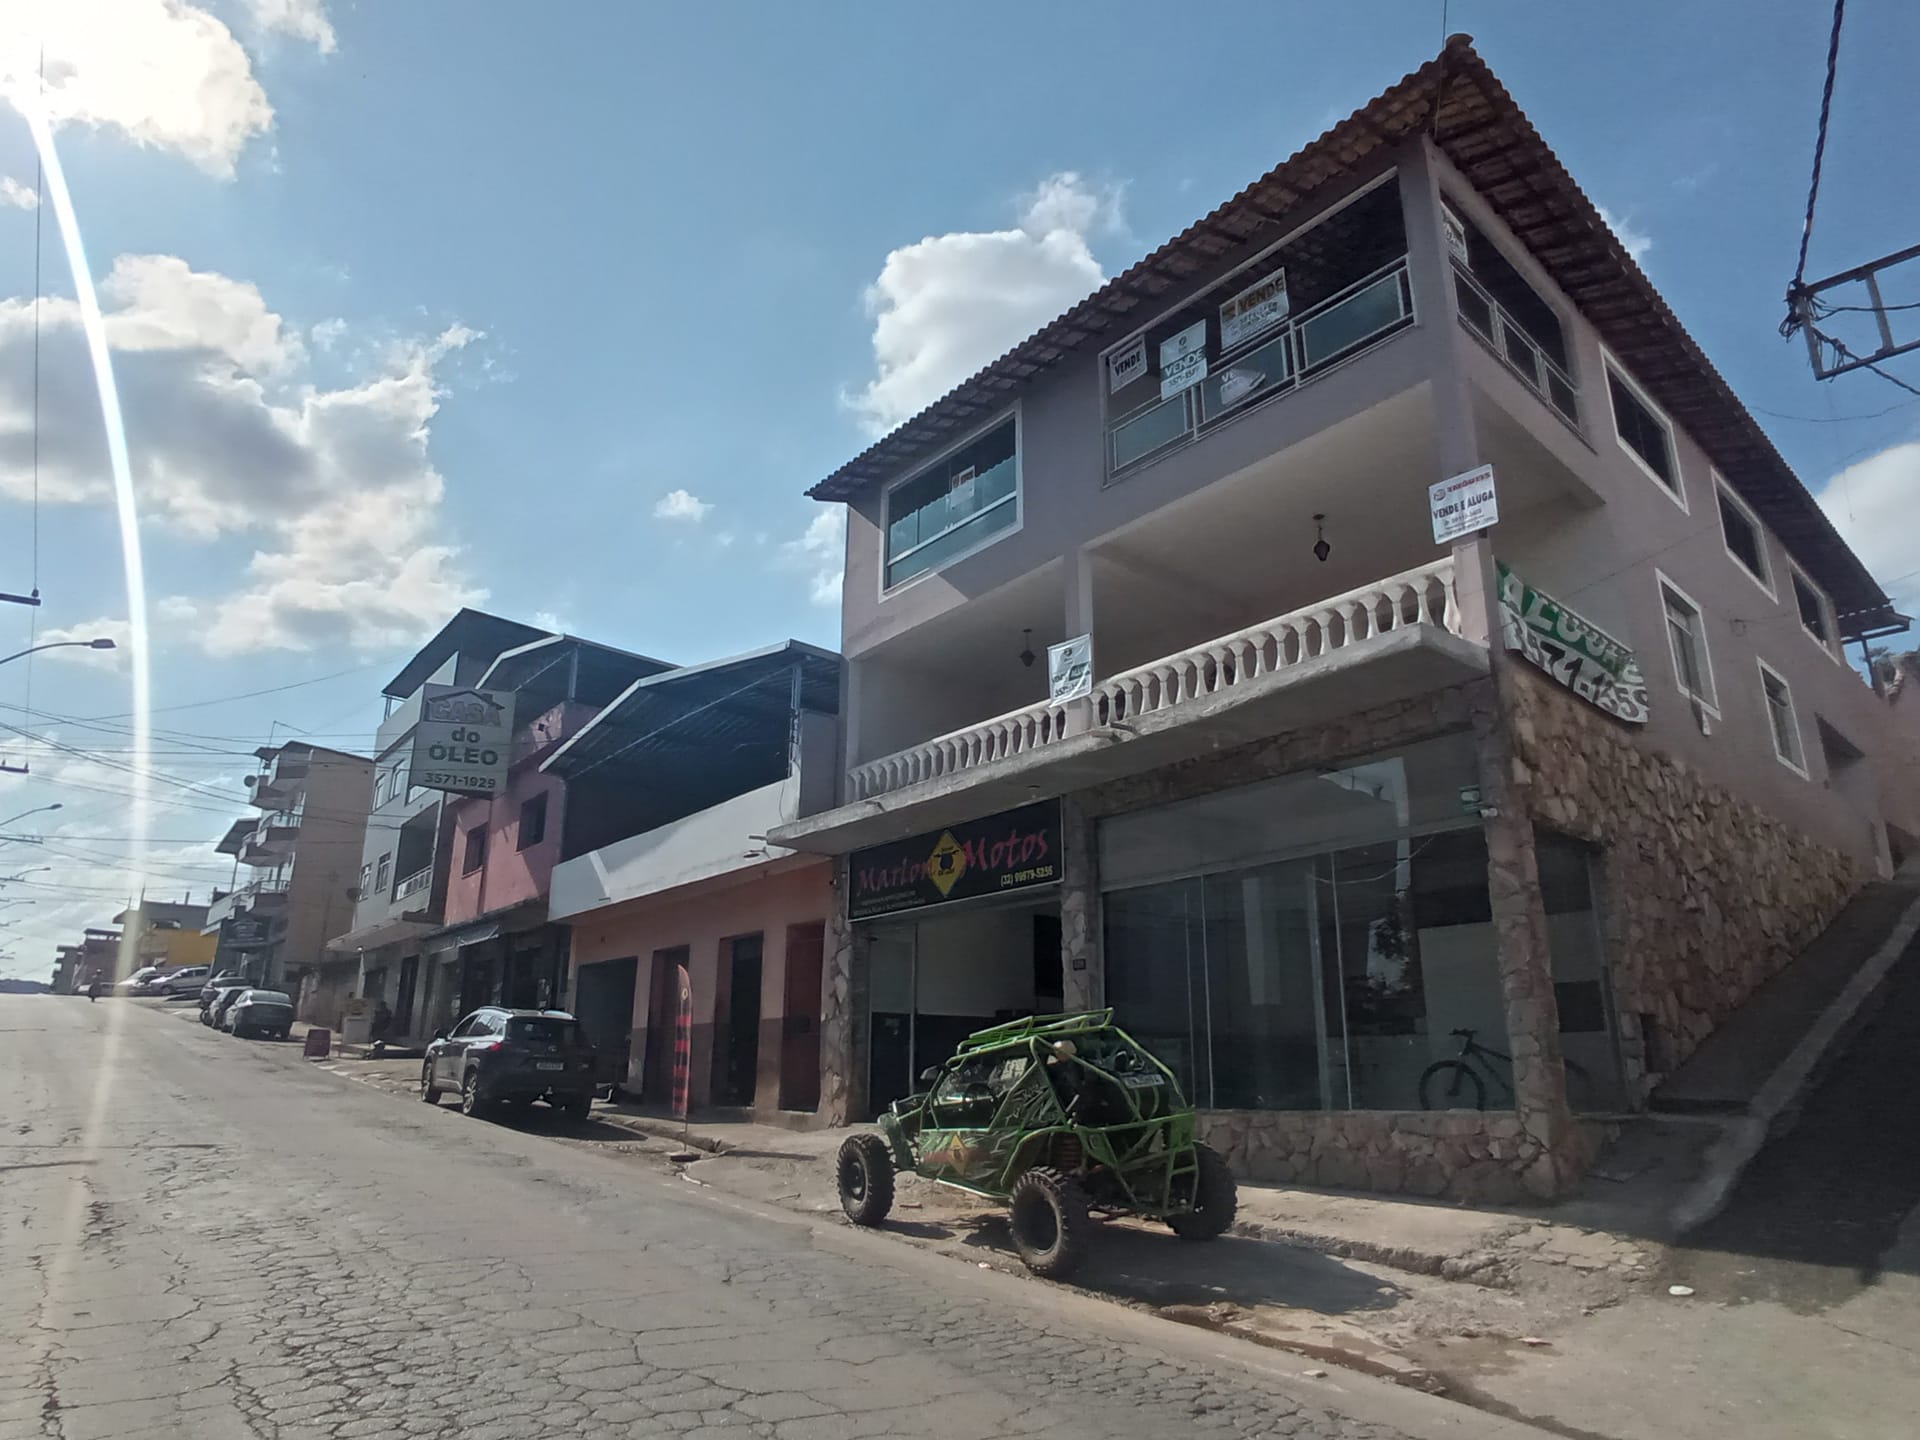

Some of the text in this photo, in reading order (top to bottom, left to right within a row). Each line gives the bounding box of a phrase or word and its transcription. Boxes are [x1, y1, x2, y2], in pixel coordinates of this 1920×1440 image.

[1115, 351, 1140, 376] VENDE
[1164, 348, 1205, 378] VENDE
[1433, 503, 1459, 519] VENDE
[1460, 501, 1466, 511] E
[1467, 490, 1494, 508] ALUGA
[451, 727, 480, 743] do
[429, 741, 498, 766] ÓLEO
[424, 772, 496, 789] 3571-1929
[964, 829, 1048, 872] Motos
